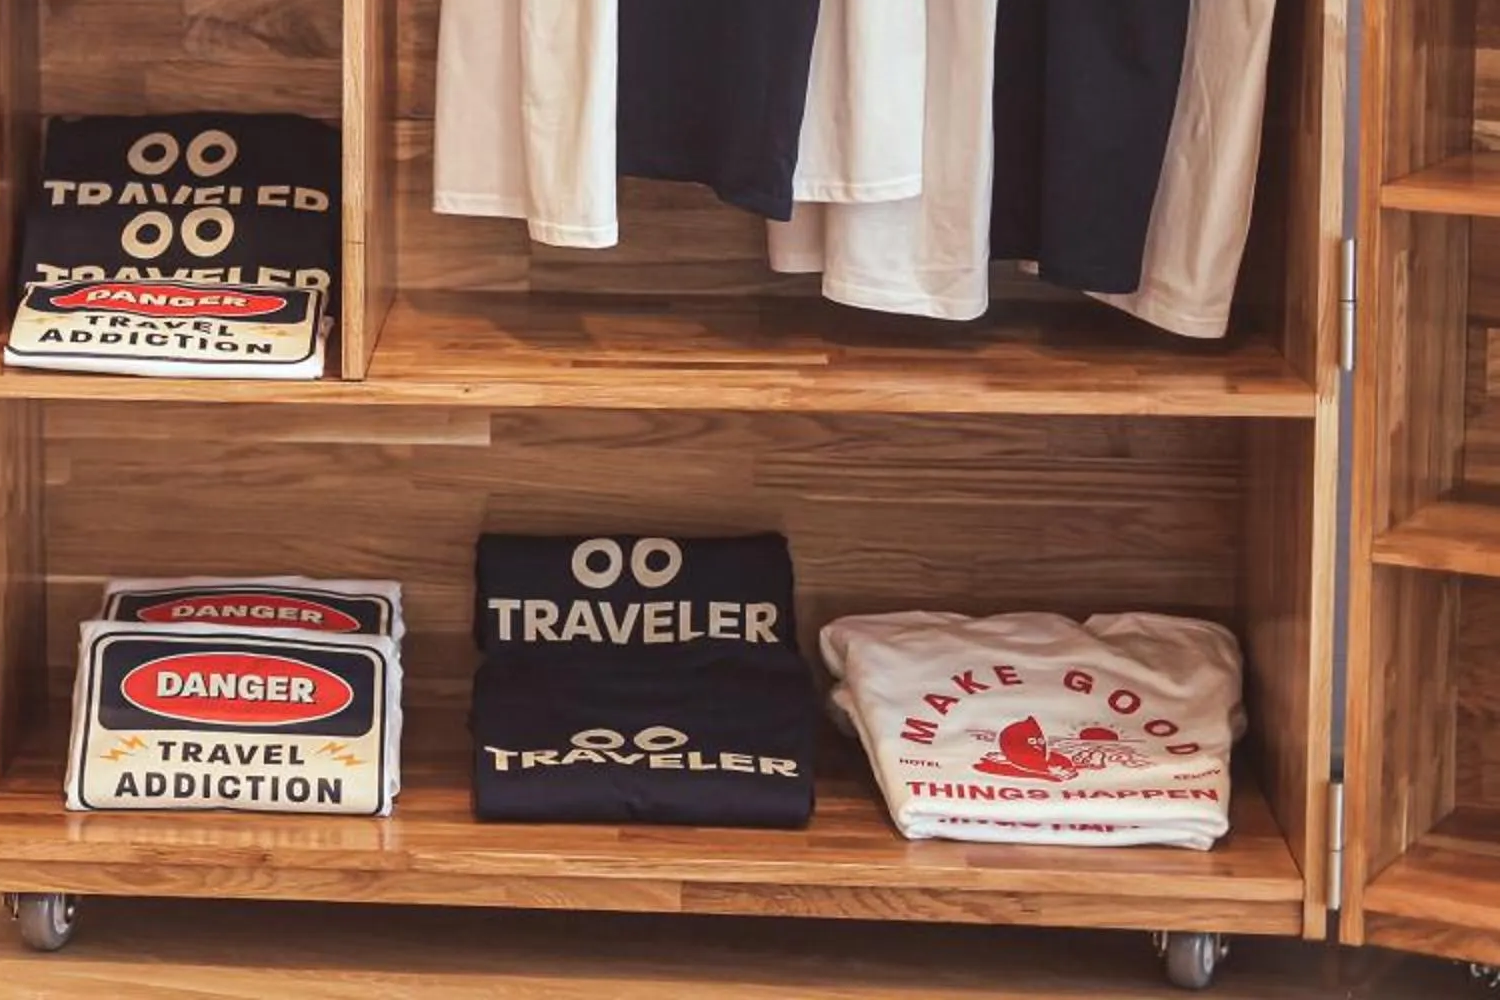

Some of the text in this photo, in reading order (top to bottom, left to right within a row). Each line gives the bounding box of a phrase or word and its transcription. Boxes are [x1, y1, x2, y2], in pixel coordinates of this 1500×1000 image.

[86, 289, 251, 308] DANGER
[84, 315, 236, 337] TRAVEL
[38, 328, 273, 355] ADDICTION
[170, 604, 325, 625] DANGER
[487, 597, 779, 645] TRAVELER
[156, 671, 317, 704] DANGER
[899, 665, 1201, 756] MAKE GOOD
[157, 741, 305, 766] TRAVEL
[483, 745, 799, 778] TRAVELER
[898, 757, 942, 770] HOTEL
[113, 771, 343, 805] ADDICTION
[905, 780, 1220, 804] THINGS HAPPEN
